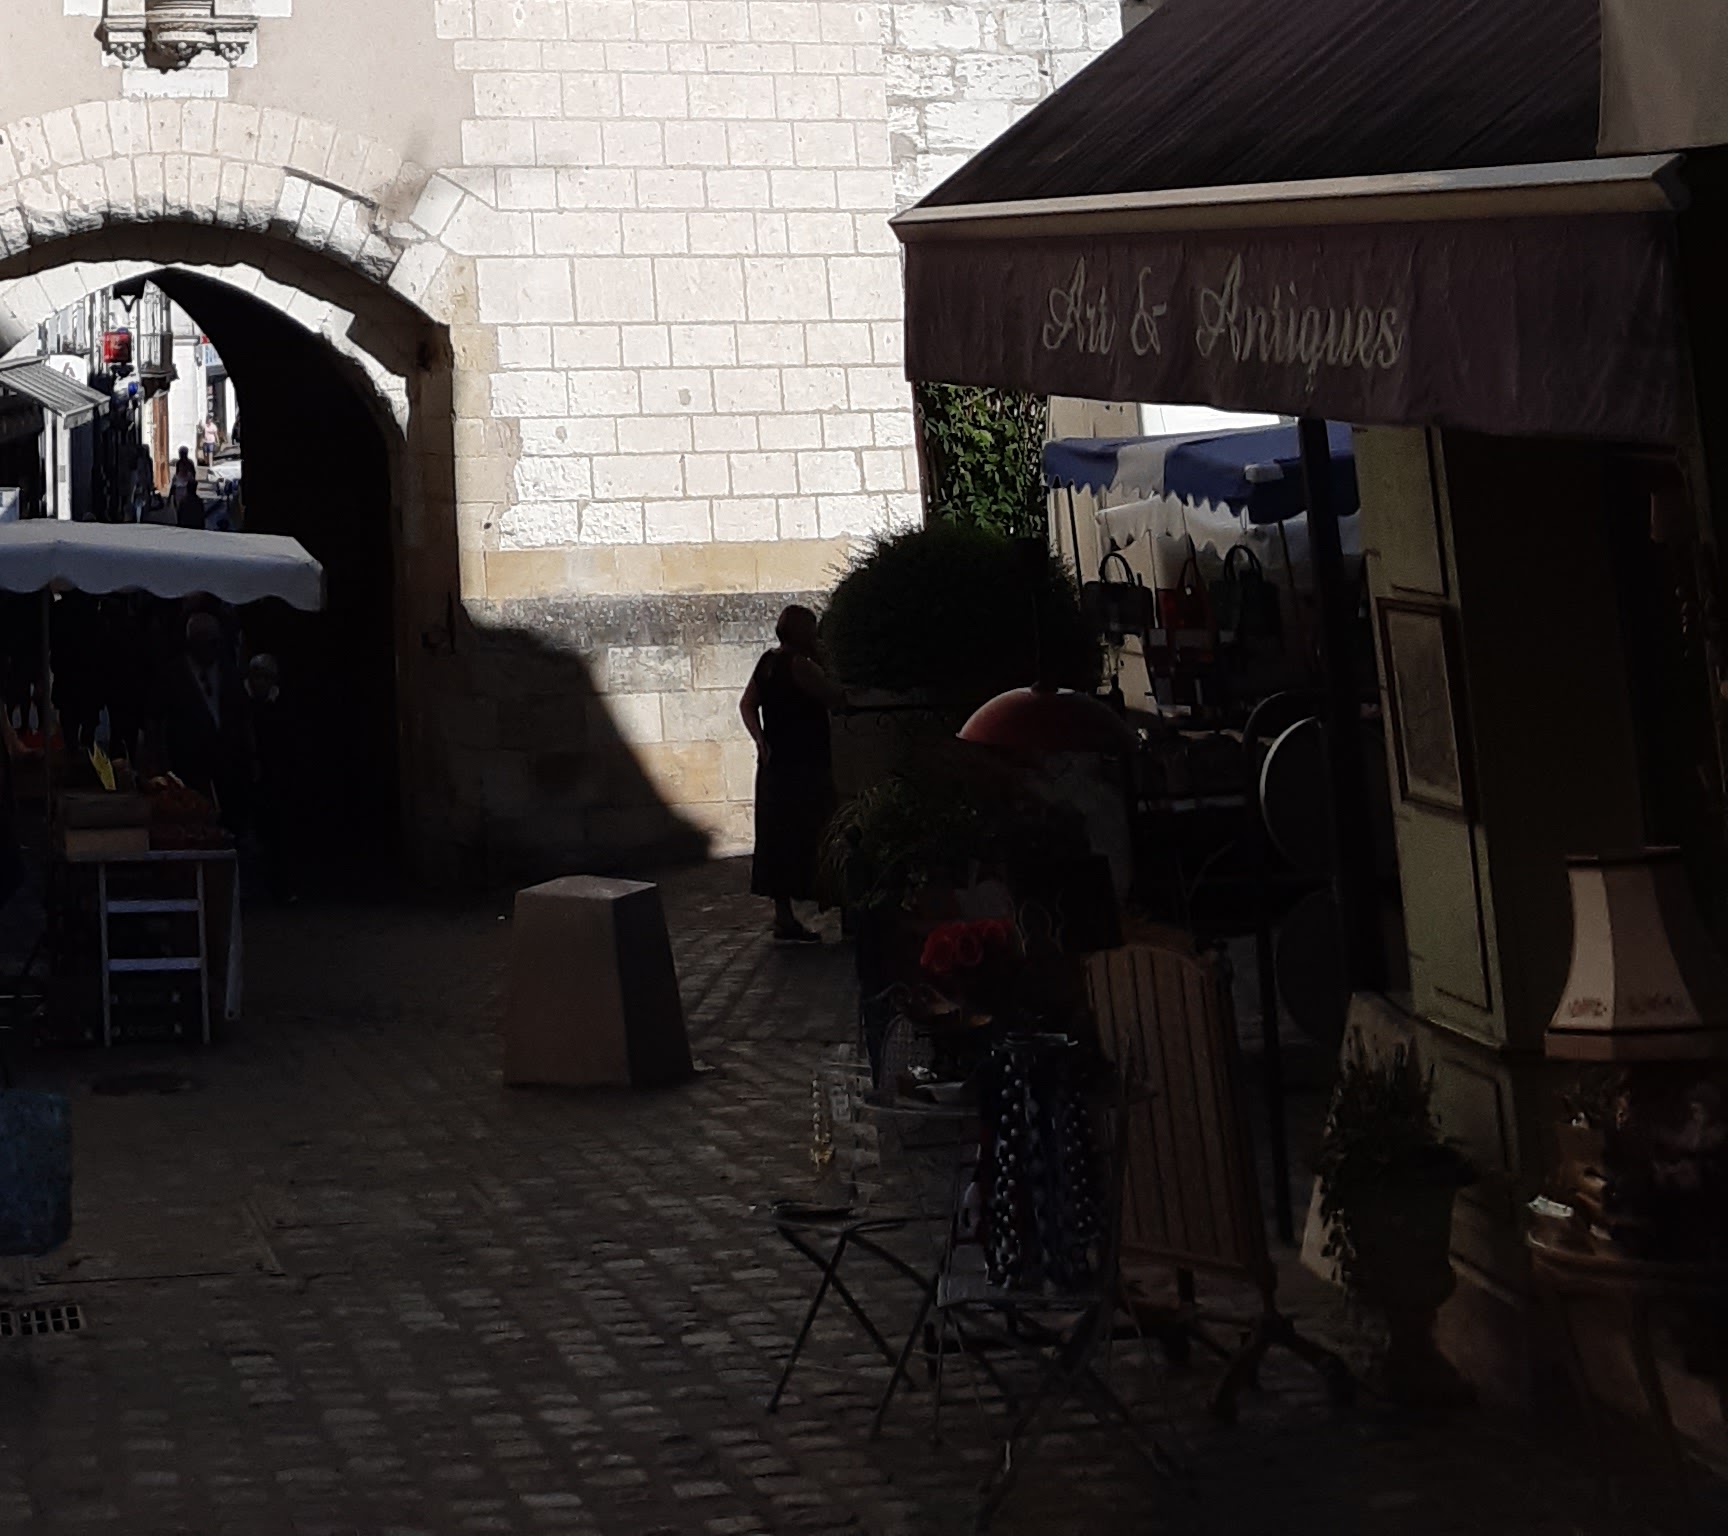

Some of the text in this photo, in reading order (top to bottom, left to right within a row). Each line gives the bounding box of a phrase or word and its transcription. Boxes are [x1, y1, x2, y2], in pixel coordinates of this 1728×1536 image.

[1043, 252, 1404, 388] Art & Antiques
